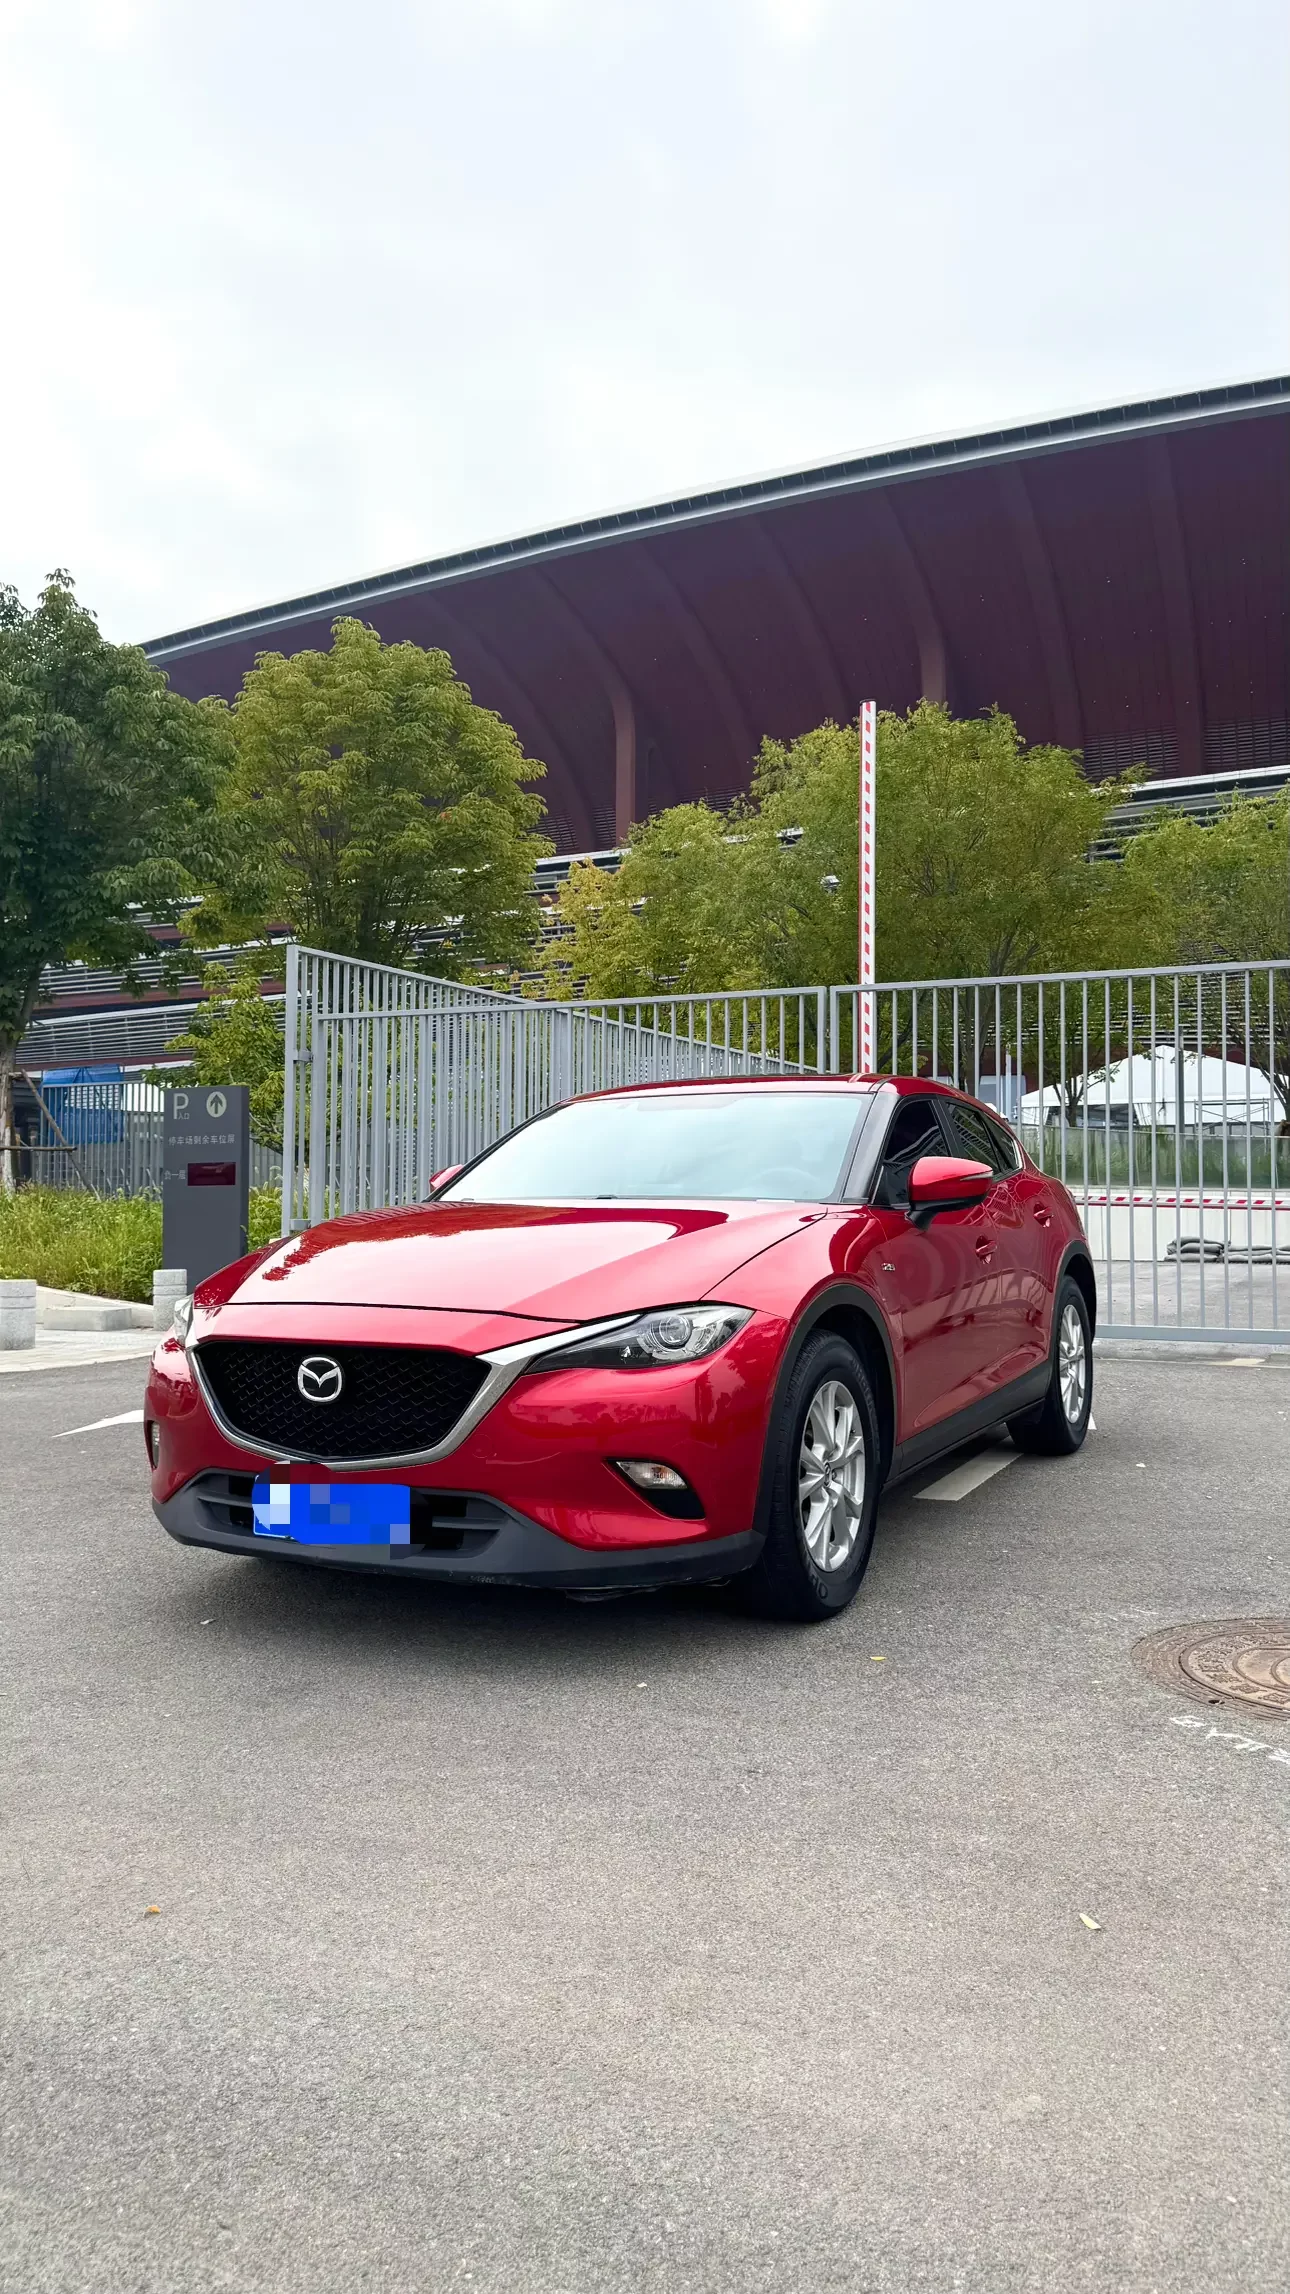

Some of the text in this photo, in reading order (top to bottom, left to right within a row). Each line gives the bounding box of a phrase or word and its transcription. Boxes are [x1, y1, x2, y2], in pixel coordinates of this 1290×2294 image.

[173, 1092, 189, 1120] P
[178, 1112, 190, 1120] 入口
[168, 1133, 236, 1146] 停车场剩余车位屏
